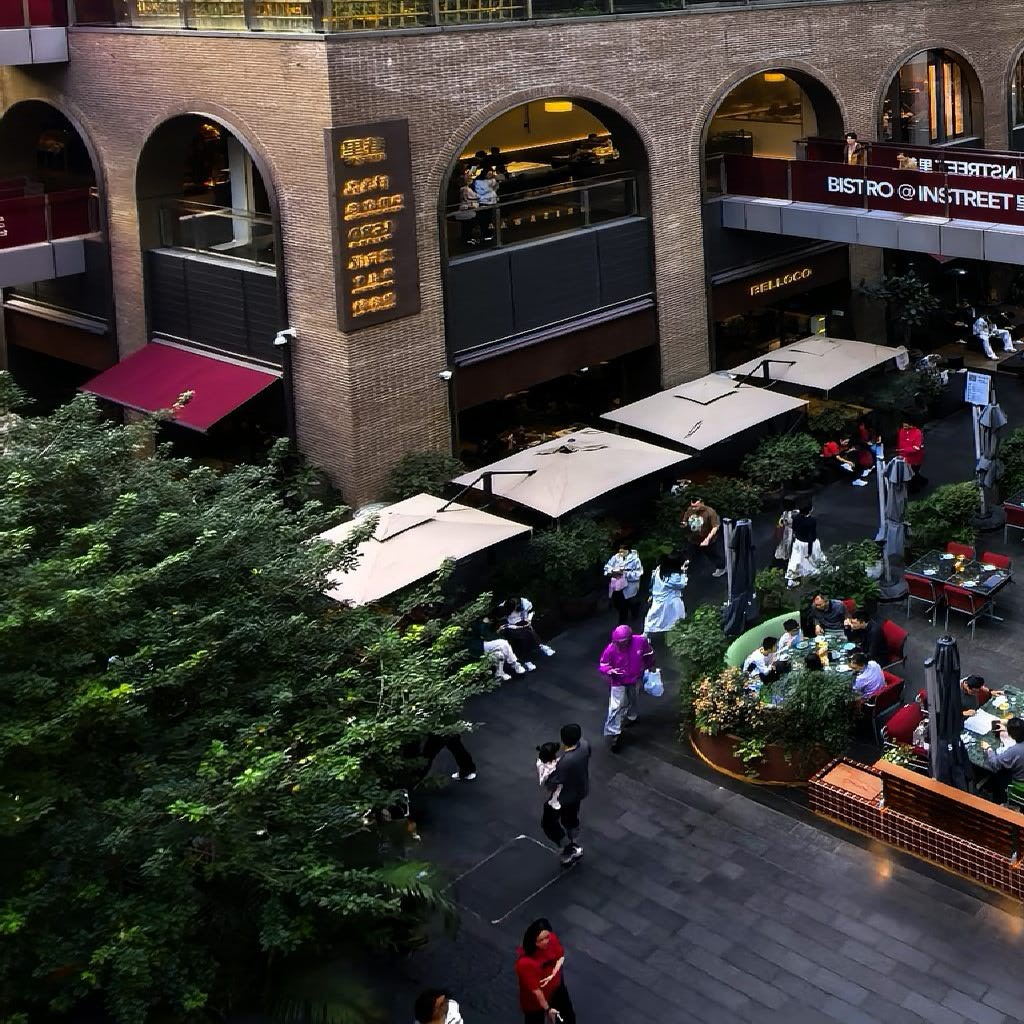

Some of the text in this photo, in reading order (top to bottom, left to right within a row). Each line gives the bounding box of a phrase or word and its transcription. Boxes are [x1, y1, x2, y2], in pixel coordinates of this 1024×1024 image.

[827, 175, 893, 198] BISTRO
[898, 183, 916, 201] @
[918, 185, 1013, 210] INSTREET
